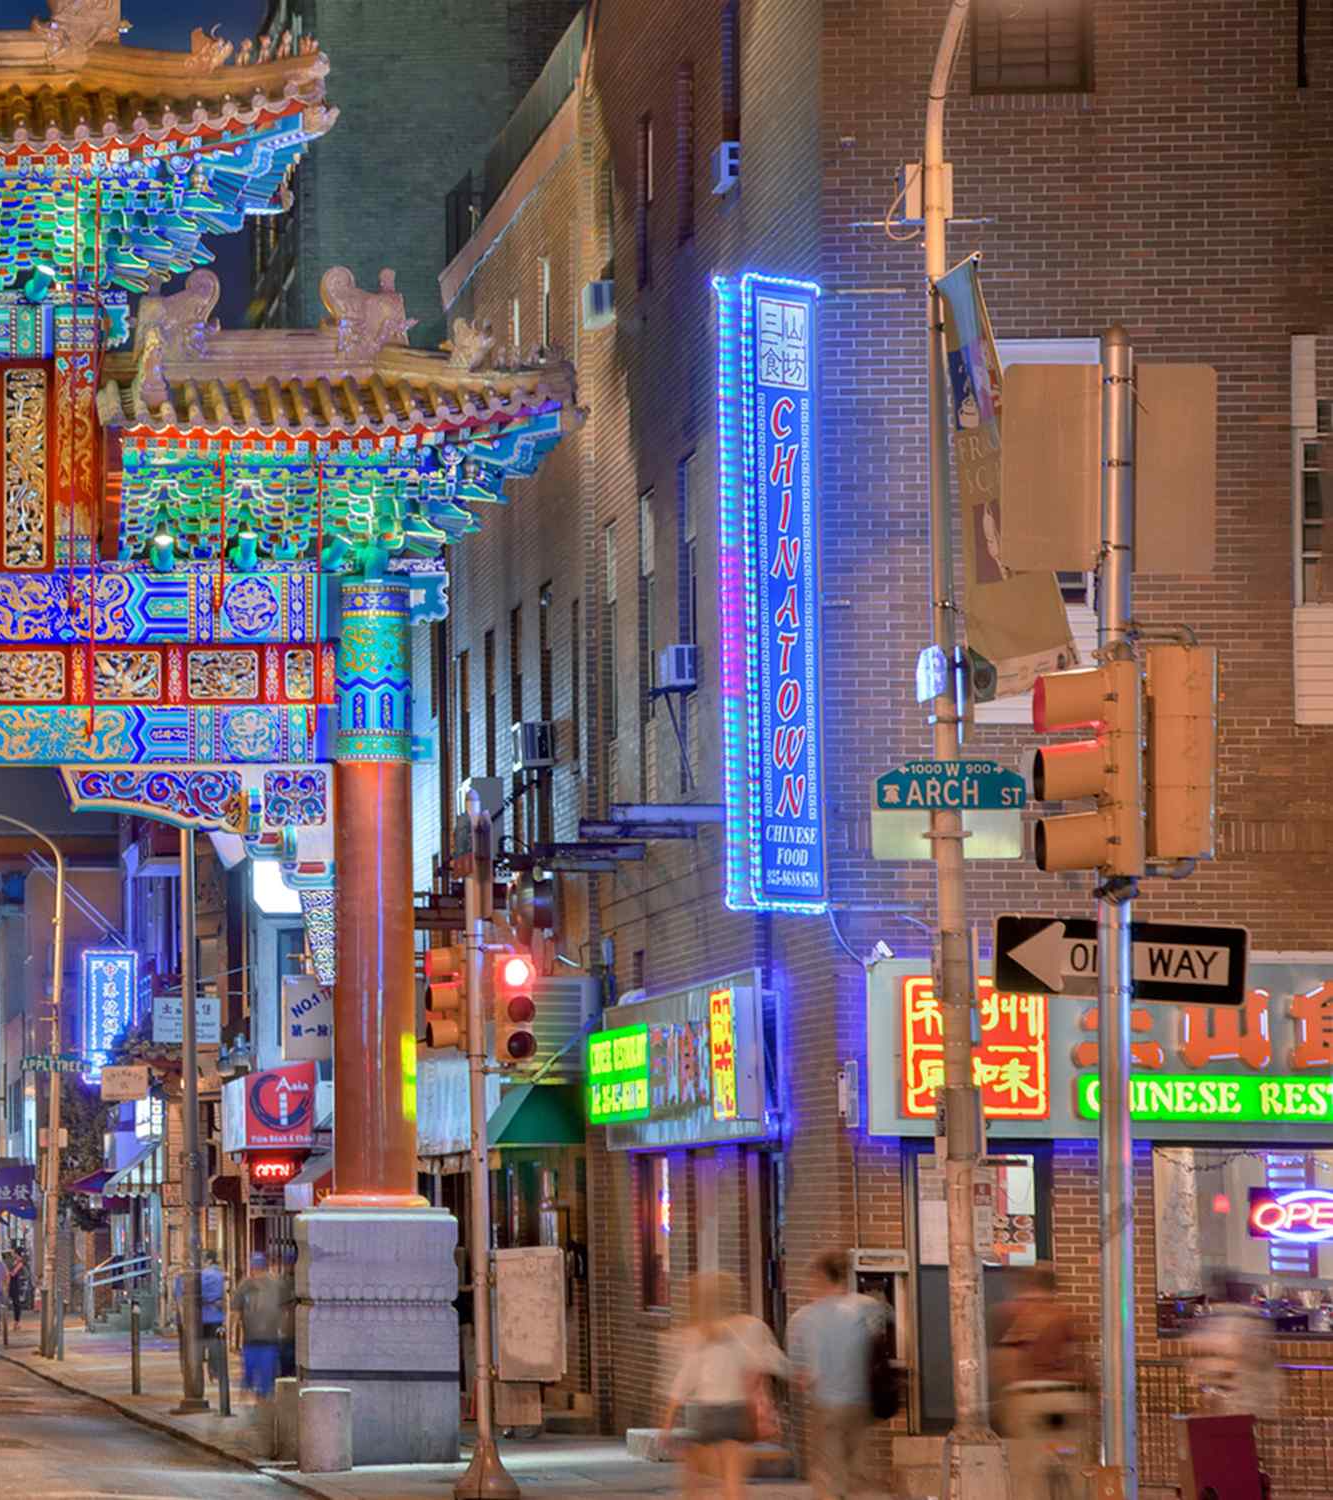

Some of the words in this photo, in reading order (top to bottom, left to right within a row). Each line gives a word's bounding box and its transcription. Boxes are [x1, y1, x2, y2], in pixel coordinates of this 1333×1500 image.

[770, 396, 806, 819] CHINATOWN
[910, 763, 942, 775] 1000
[945, 763, 960, 777] W
[965, 763, 992, 775] 900
[905, 779, 980, 806] ARCH
[1001, 787, 1023, 806] ST
[766, 824, 819, 845] CHINESE
[776, 847, 809, 867] FOOD
[1148, 947, 1218, 979] WAY
[1085, 1080, 1242, 1115] CINESE
